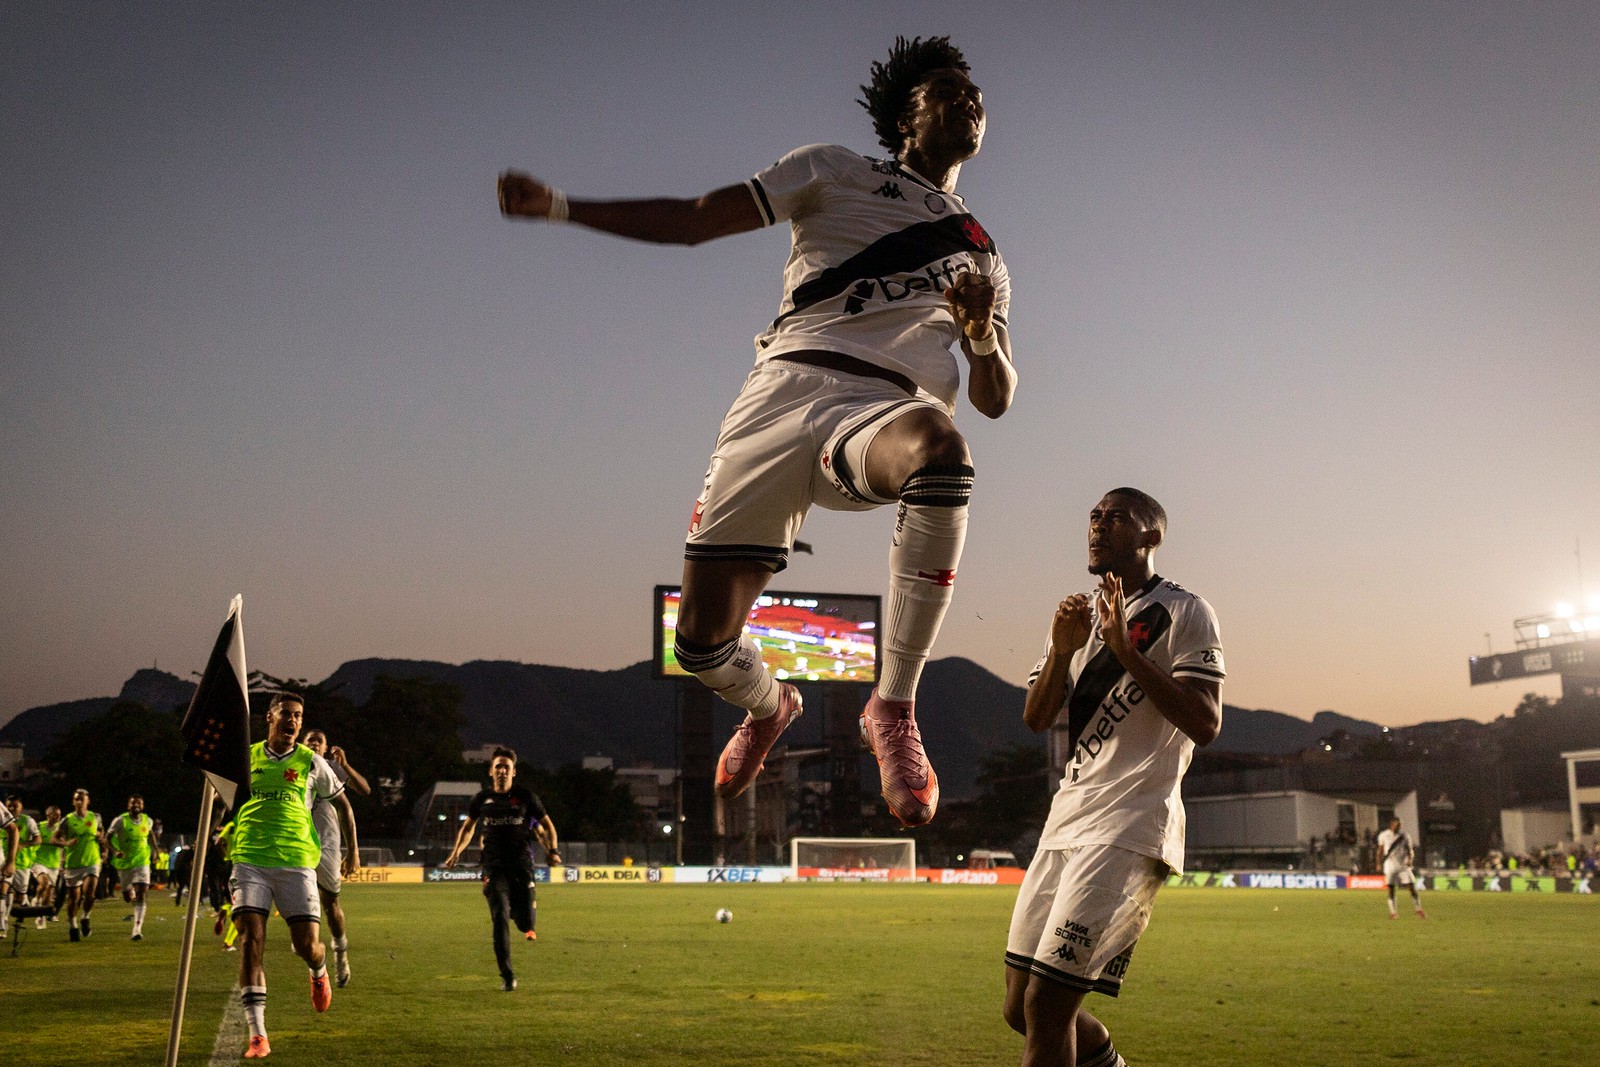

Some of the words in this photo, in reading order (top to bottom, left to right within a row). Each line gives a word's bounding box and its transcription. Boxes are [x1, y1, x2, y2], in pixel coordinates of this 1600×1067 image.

[1078, 676, 1147, 760] betfa
[443, 872, 475, 880] Cruzeiro
[585, 871, 609, 880] BOA
[614, 871, 641, 880] IDEIA
[706, 868, 763, 882] 1XBET
[941, 869, 998, 884] Betano
[1251, 873, 1283, 888] VIVA
[1285, 874, 1337, 889] SORTE
[1065, 920, 1089, 935] VIVA
[1055, 927, 1092, 947] SORTE
